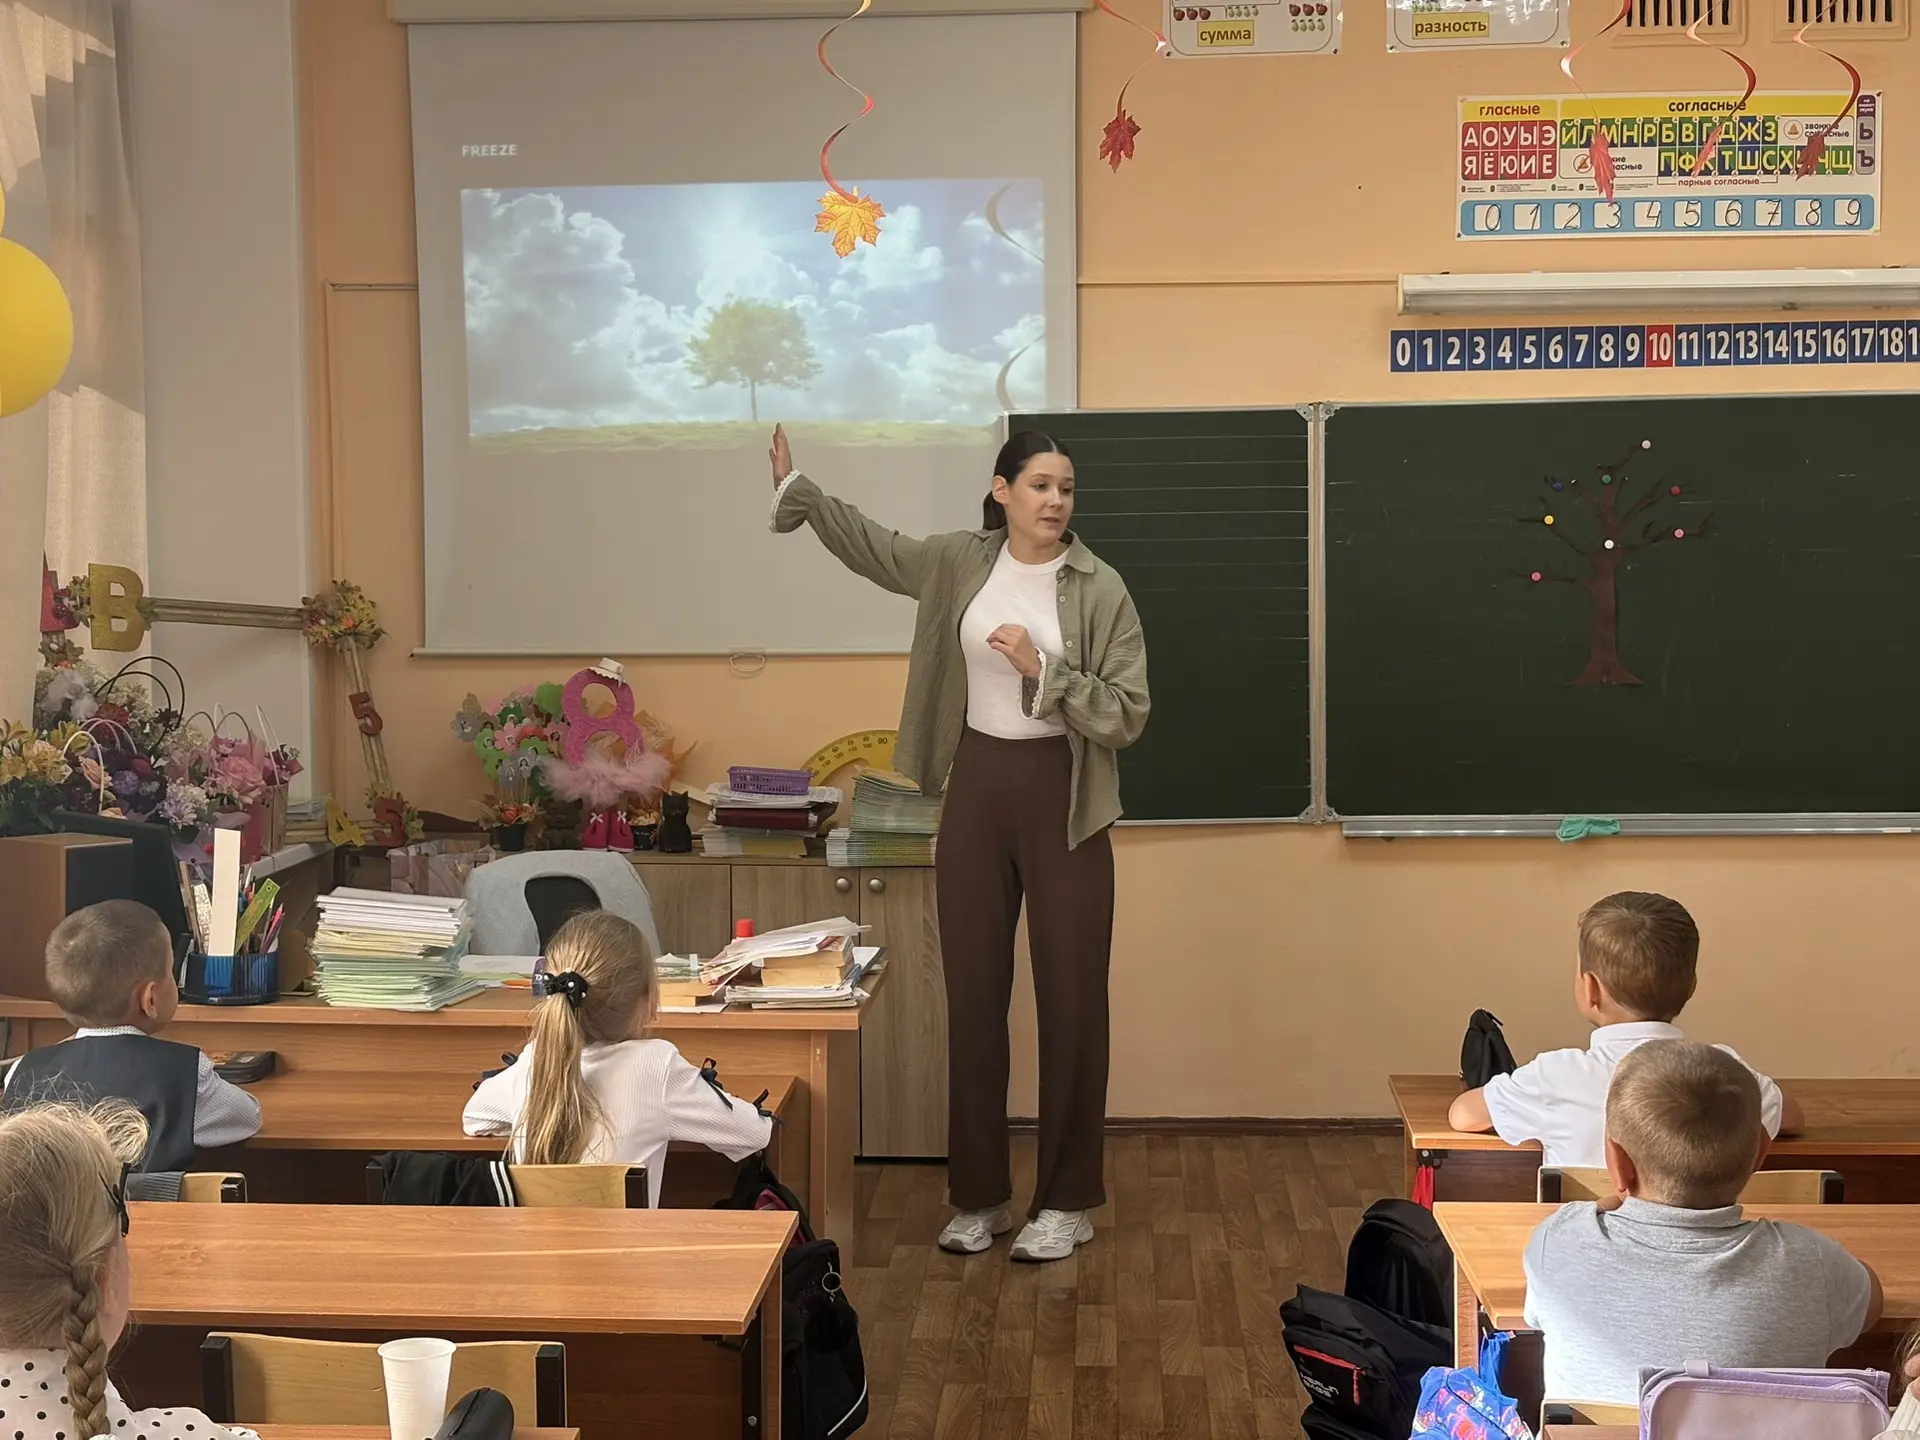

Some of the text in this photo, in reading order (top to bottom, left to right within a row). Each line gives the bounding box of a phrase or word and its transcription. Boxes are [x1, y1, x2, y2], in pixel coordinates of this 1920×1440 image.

[1415, 21, 1487, 36] разность
[1200, 28, 1251, 44] сумма
[1479, 104, 1541, 116] гласные
[1669, 101, 1746, 112] согласные
[462, 144, 517, 157] FREEZE
[1678, 178, 1760, 187] парные согласные
[1485, 199, 1861, 230] 0 1 2 3 4 5 6 7 8 9
[1396, 327, 1920, 366] 0 1 2 3 4 5 6 7 8 9 10 11 12 13 14 15 16 17 18 1
[877, 737, 888, 745] 90
